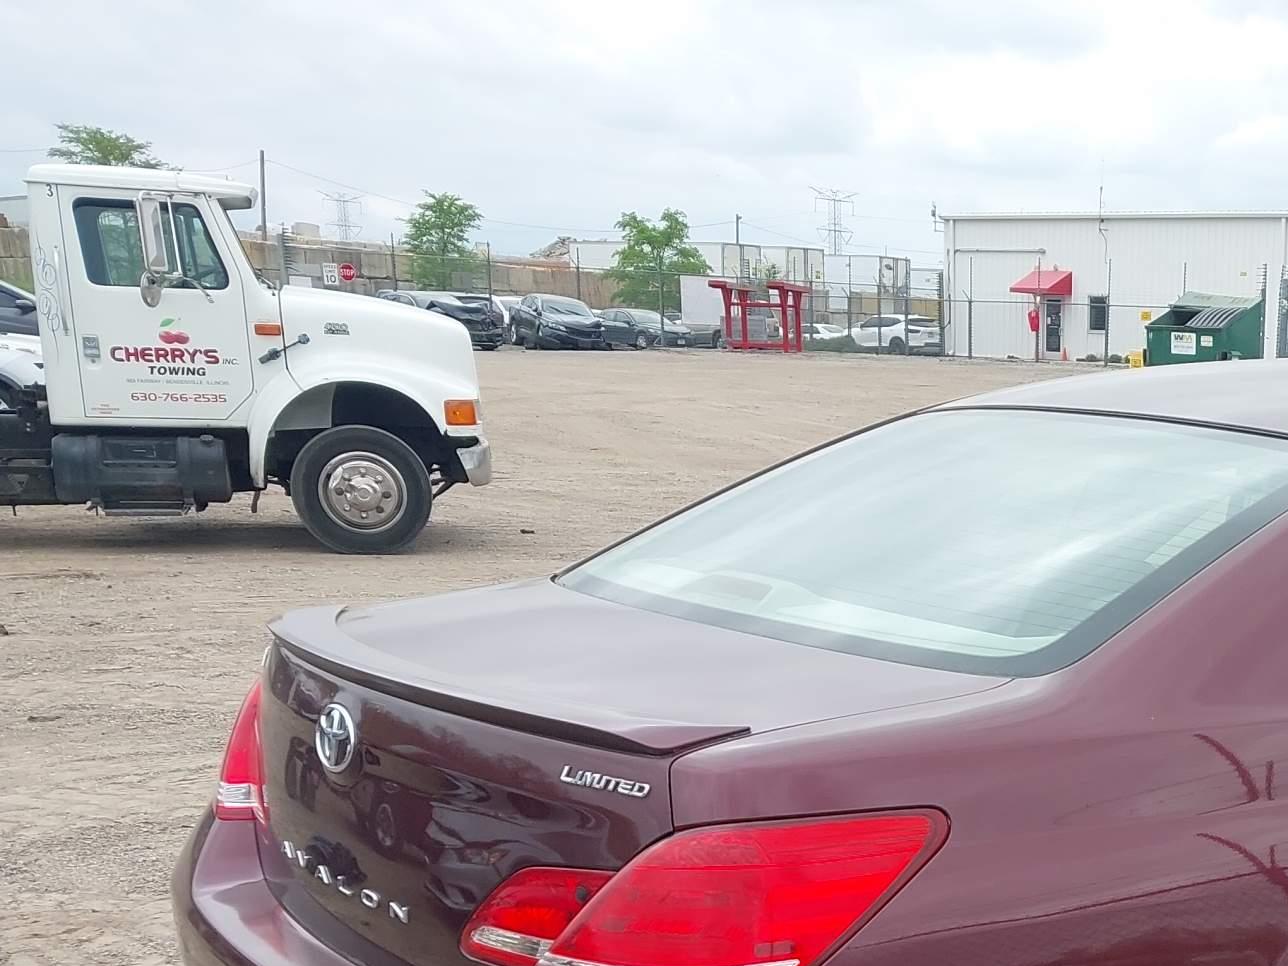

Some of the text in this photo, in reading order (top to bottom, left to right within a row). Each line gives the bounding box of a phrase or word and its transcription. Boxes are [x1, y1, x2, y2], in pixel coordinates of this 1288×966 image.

[46, 183, 53, 197] 3
[326, 274, 336, 283] 10
[110, 346, 239, 366] CHERRY'S INC.
[148, 366, 206, 377] TOWING
[130, 392, 228, 403] 630-766-2535
[560, 765, 650, 797] LIMITED
[281, 840, 409, 924] AVALON
